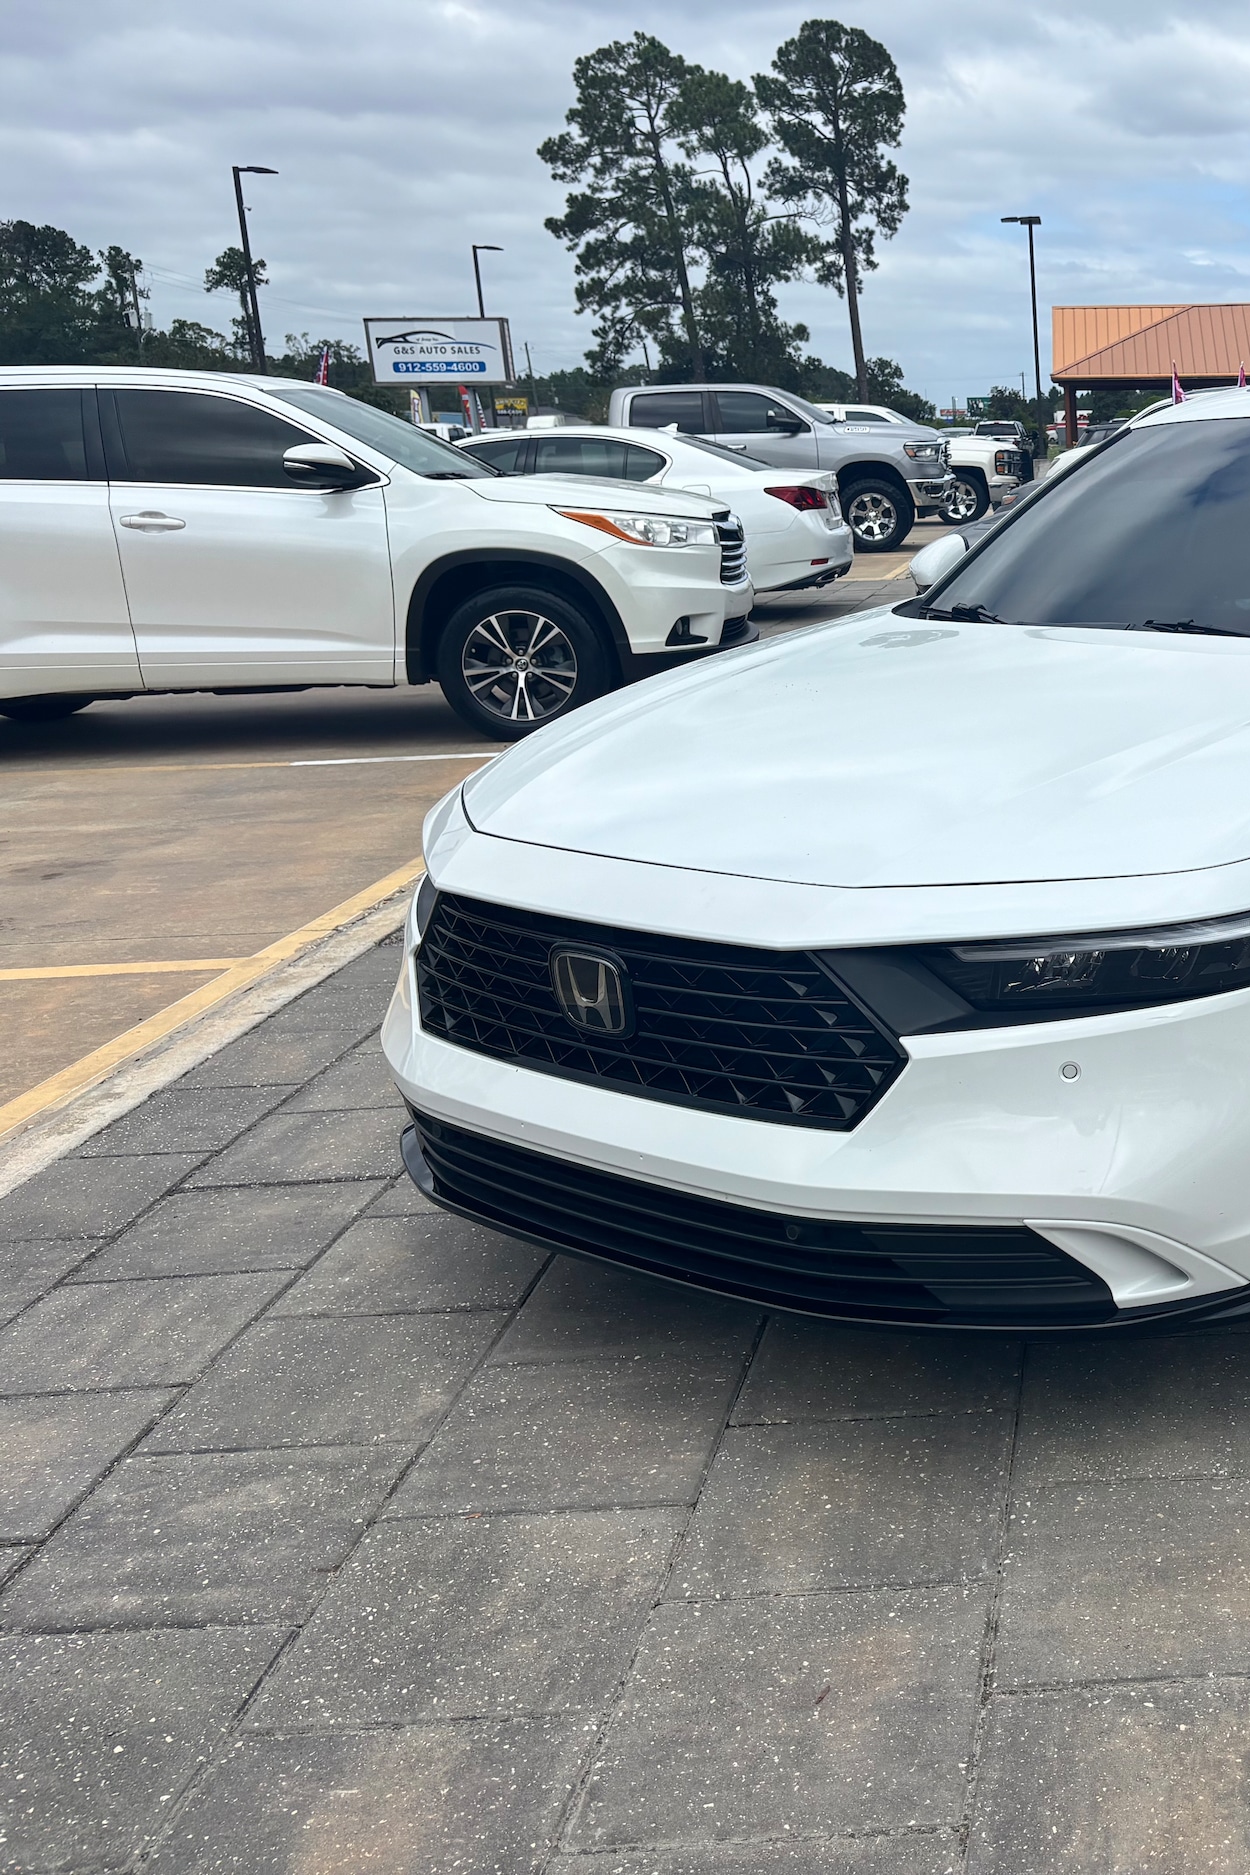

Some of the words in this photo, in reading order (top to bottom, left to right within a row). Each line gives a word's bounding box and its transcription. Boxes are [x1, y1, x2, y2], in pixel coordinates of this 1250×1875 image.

[393, 346, 415, 355] G&S
[419, 346, 447, 355] AUTO
[451, 346, 481, 355] SALES
[398, 363, 480, 372] 912-559-4600
